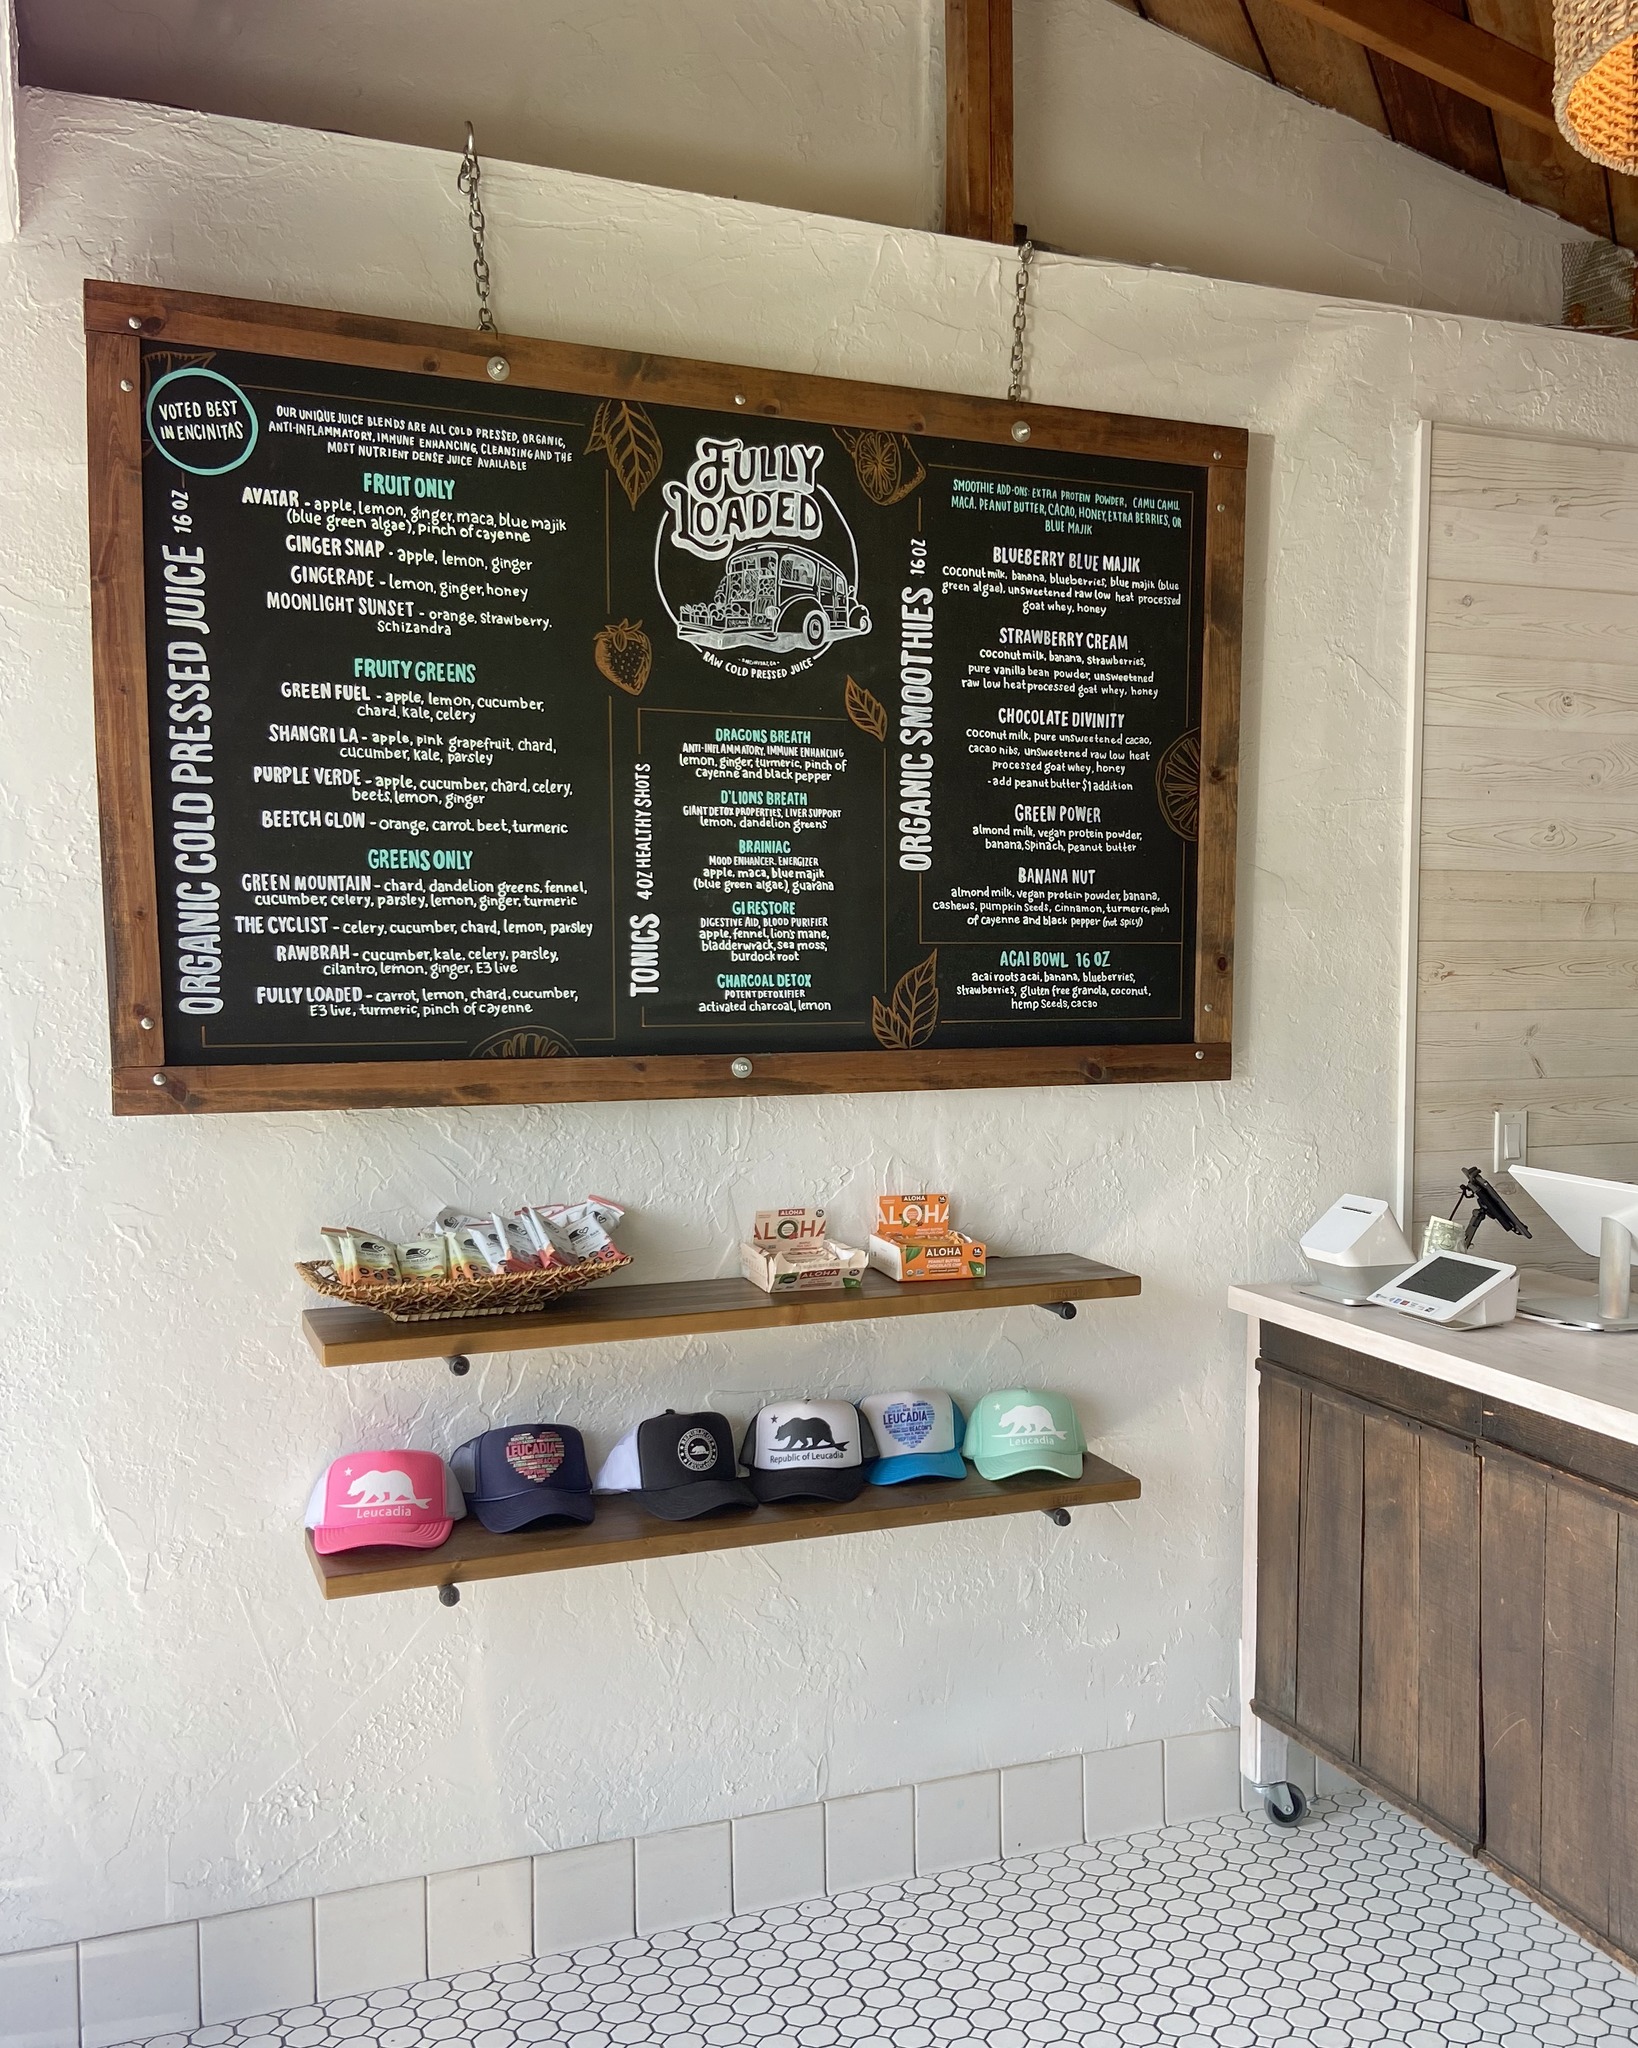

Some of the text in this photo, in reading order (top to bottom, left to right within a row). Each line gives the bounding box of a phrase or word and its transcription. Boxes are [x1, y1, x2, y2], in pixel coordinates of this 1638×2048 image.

[159, 400, 238, 421] VOTED BEST
[160, 420, 244, 441] IN ENCINITAS
[276, 404, 565, 449] OUR UNIQUE JUICE BLENDS ARE ALL COLD PRESSED, ORGANIC,
[268, 420, 572, 463] ANTI-INFLAMMATORY, IMMUNE ENHANCING, CLEANSING AND THE
[327, 441, 526, 471] MOST NUTRIENT DENSE JUICE AVAILABLE
[687, 437, 824, 493] FULLY
[363, 472, 455, 500] FRUIT ONLY
[662, 481, 823, 561] LOADED
[1045, 519, 1092, 534] BLUE MAJIK
[285, 534, 532, 574] GINGER SNAP apple, lemon, ginger
[992, 546, 1140, 573] BLUEBERRY BLUE MAJIK
[290, 565, 528, 602] GINGERADE lemon, ginger, honey
[1022, 600, 1106, 616] goat whey, honey
[998, 627, 1128, 650] STRAWBERRY CREAM
[354, 657, 476, 683] FRUITY GREENS
[702, 651, 723, 668] RAW
[725, 662, 749, 677] COLD
[751, 668, 788, 680] PRESSED
[790, 657, 814, 675] JUICE
[968, 664, 1154, 682] pure vanilla bean powder, unsweetened
[280, 681, 544, 712] GREEN FUEL apple, lemon, cucumber,
[898, 538, 933, 871] ORGANIC SMOOTHIES 16 OZ
[998, 707, 1124, 728] CHOCOLATE DIVINITY
[715, 727, 810, 744] DRAGONS BREATH
[161, 489, 224, 1014] ORGANIC COLD PRESSED JUICE 16 OZ
[679, 753, 847, 772] lemon, ginger, turmeric, pinch of
[992, 760, 1125, 775] processed goat whey, honey
[634, 763, 652, 808] SHOTS
[695, 767, 831, 784] cayenne and black pepper
[720, 789, 807, 805] D'LIONS BREATH
[1014, 803, 1101, 823] GREEN POWER
[634, 811, 652, 868] HEALTHY
[972, 823, 1142, 842] almond milk, vegan protein powder,
[738, 839, 791, 854] BRAINIAC
[367, 848, 473, 871] GREENS ONLY
[702, 866, 825, 882] apple, maca, blue majik
[1018, 866, 1095, 884] BANANA NUT
[731, 900, 795, 916] GI RESTORE
[234, 915, 264, 934] THE
[267, 915, 328, 934] CYCLIST
[389, 919, 457, 934] cucumber,
[460, 919, 500, 935] chard,
[503, 918, 546, 934] lemon,
[550, 920, 593, 937] parsley
[629, 913, 660, 997] TONICS
[730, 949, 799, 962] burdock root
[1000, 949, 1110, 968] ACAI BOWL 16 OZ
[322, 960, 518, 980] cilantro, lemon, ginger, E3 live
[716, 973, 811, 988] CHARCOAL DETOX
[698, 999, 831, 1012] activated charcoal, lemon
[926, 1247, 962, 1257] ALOHA
[801, 1269, 838, 1278] ALOHA
[883, 1410, 928, 1425] LEUCADIA
[506, 1442, 557, 1459] LEUCADIA
[1009, 1434, 1055, 1447] Leucadia
[770, 1450, 844, 1465] Republic of Leucadia
[356, 1505, 412, 1519] Leucadia
